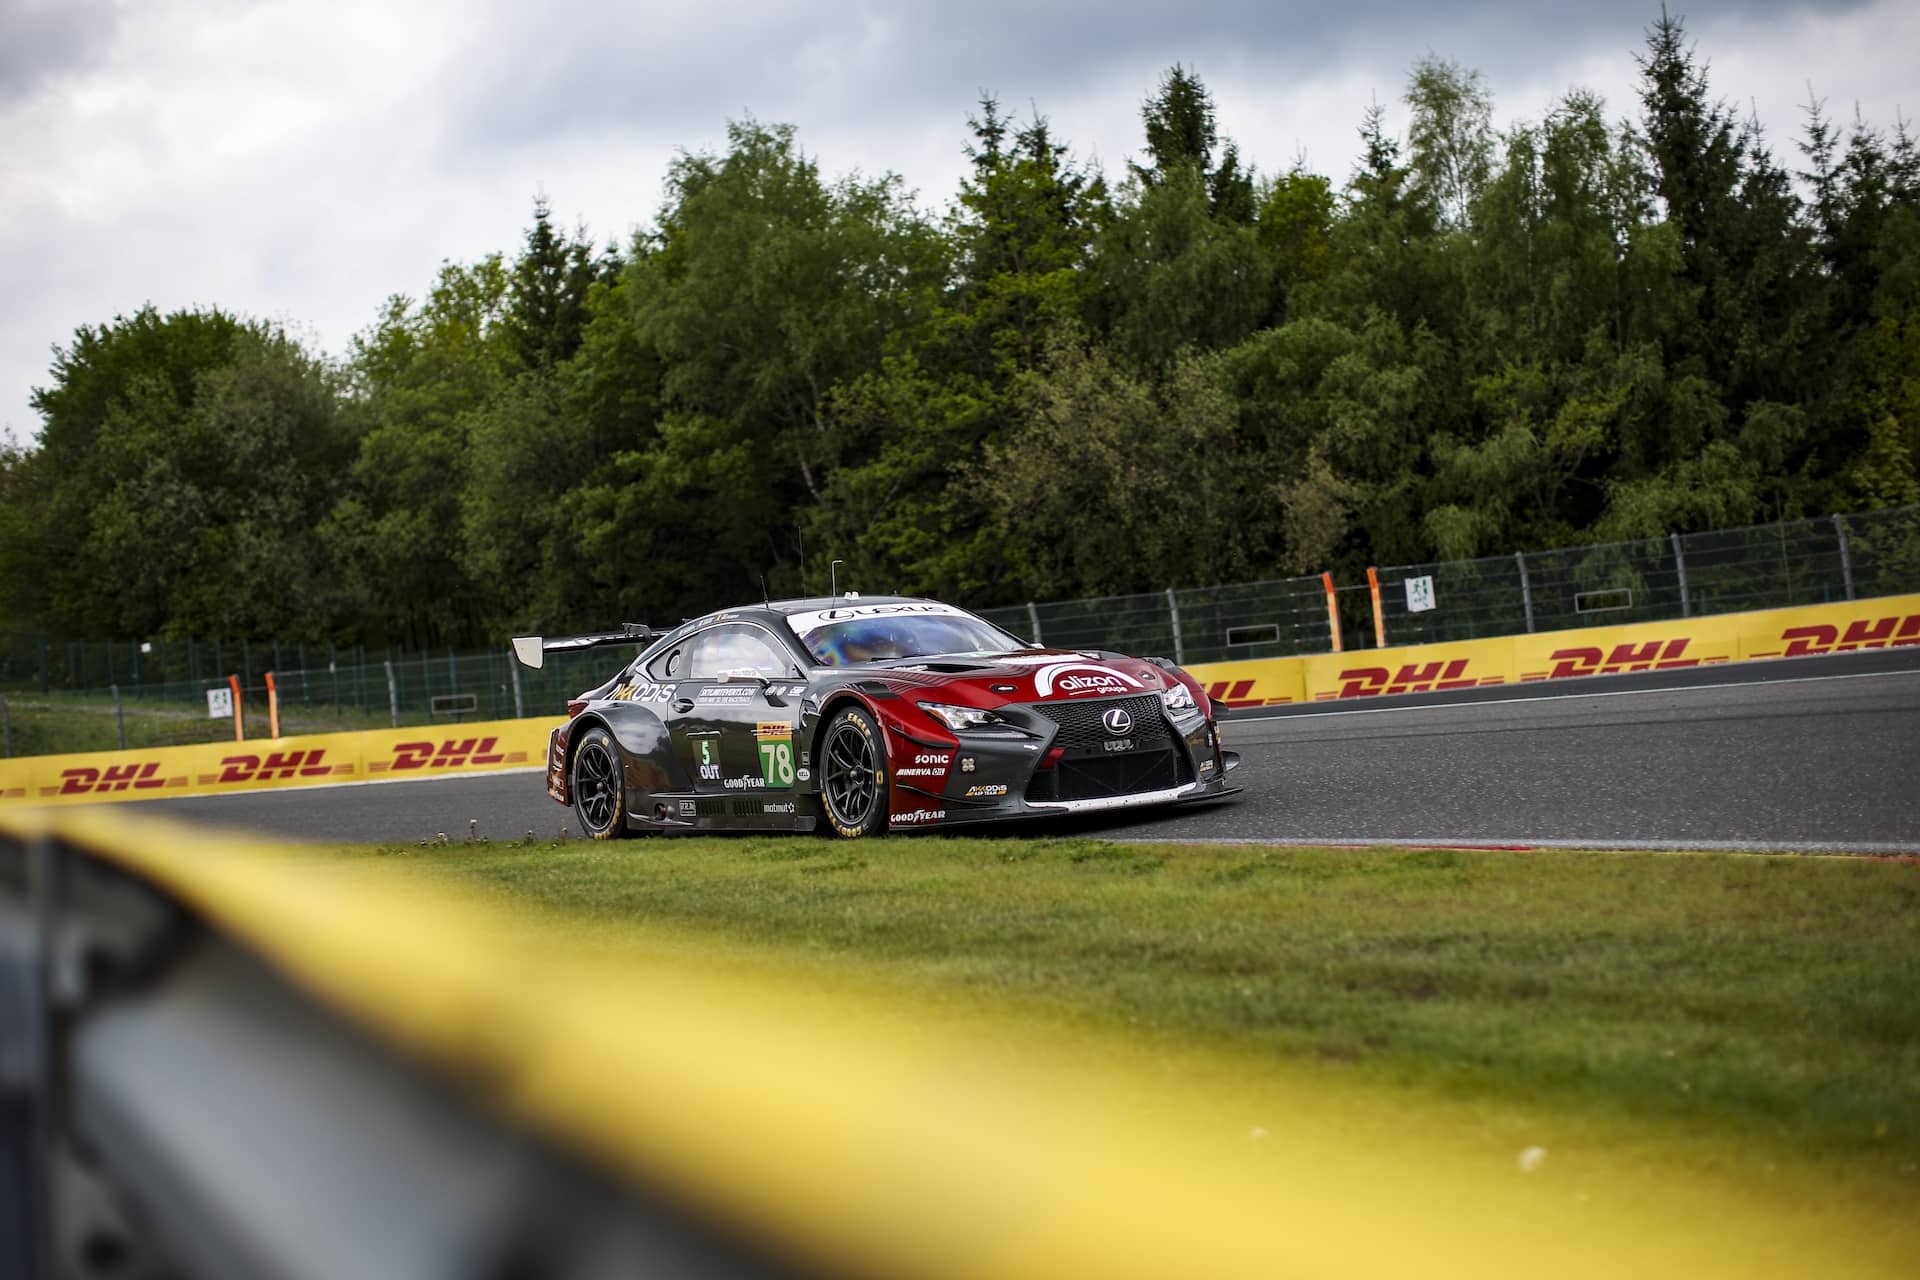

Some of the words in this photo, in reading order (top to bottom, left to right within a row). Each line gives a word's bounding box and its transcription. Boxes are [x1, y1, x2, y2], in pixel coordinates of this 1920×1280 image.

[856, 605, 949, 615] LEXUS
[1549, 637, 1701, 679] DHL
[1059, 675, 1122, 690] alizon
[1097, 686, 1128, 694] groupe
[1337, 658, 1478, 699] DHL
[847, 712, 872, 738] EAGLE
[391, 737, 505, 770] DHL
[701, 740, 711, 765] 5
[761, 743, 794, 784] 78
[60, 763, 165, 795] DHL
[219, 750, 332, 783] DHL
[700, 765, 720, 780] OUT
[896, 768, 931, 776] MINERVA
[724, 775, 766, 791] GOODYEAR
[890, 810, 946, 823] GOODYEAR
